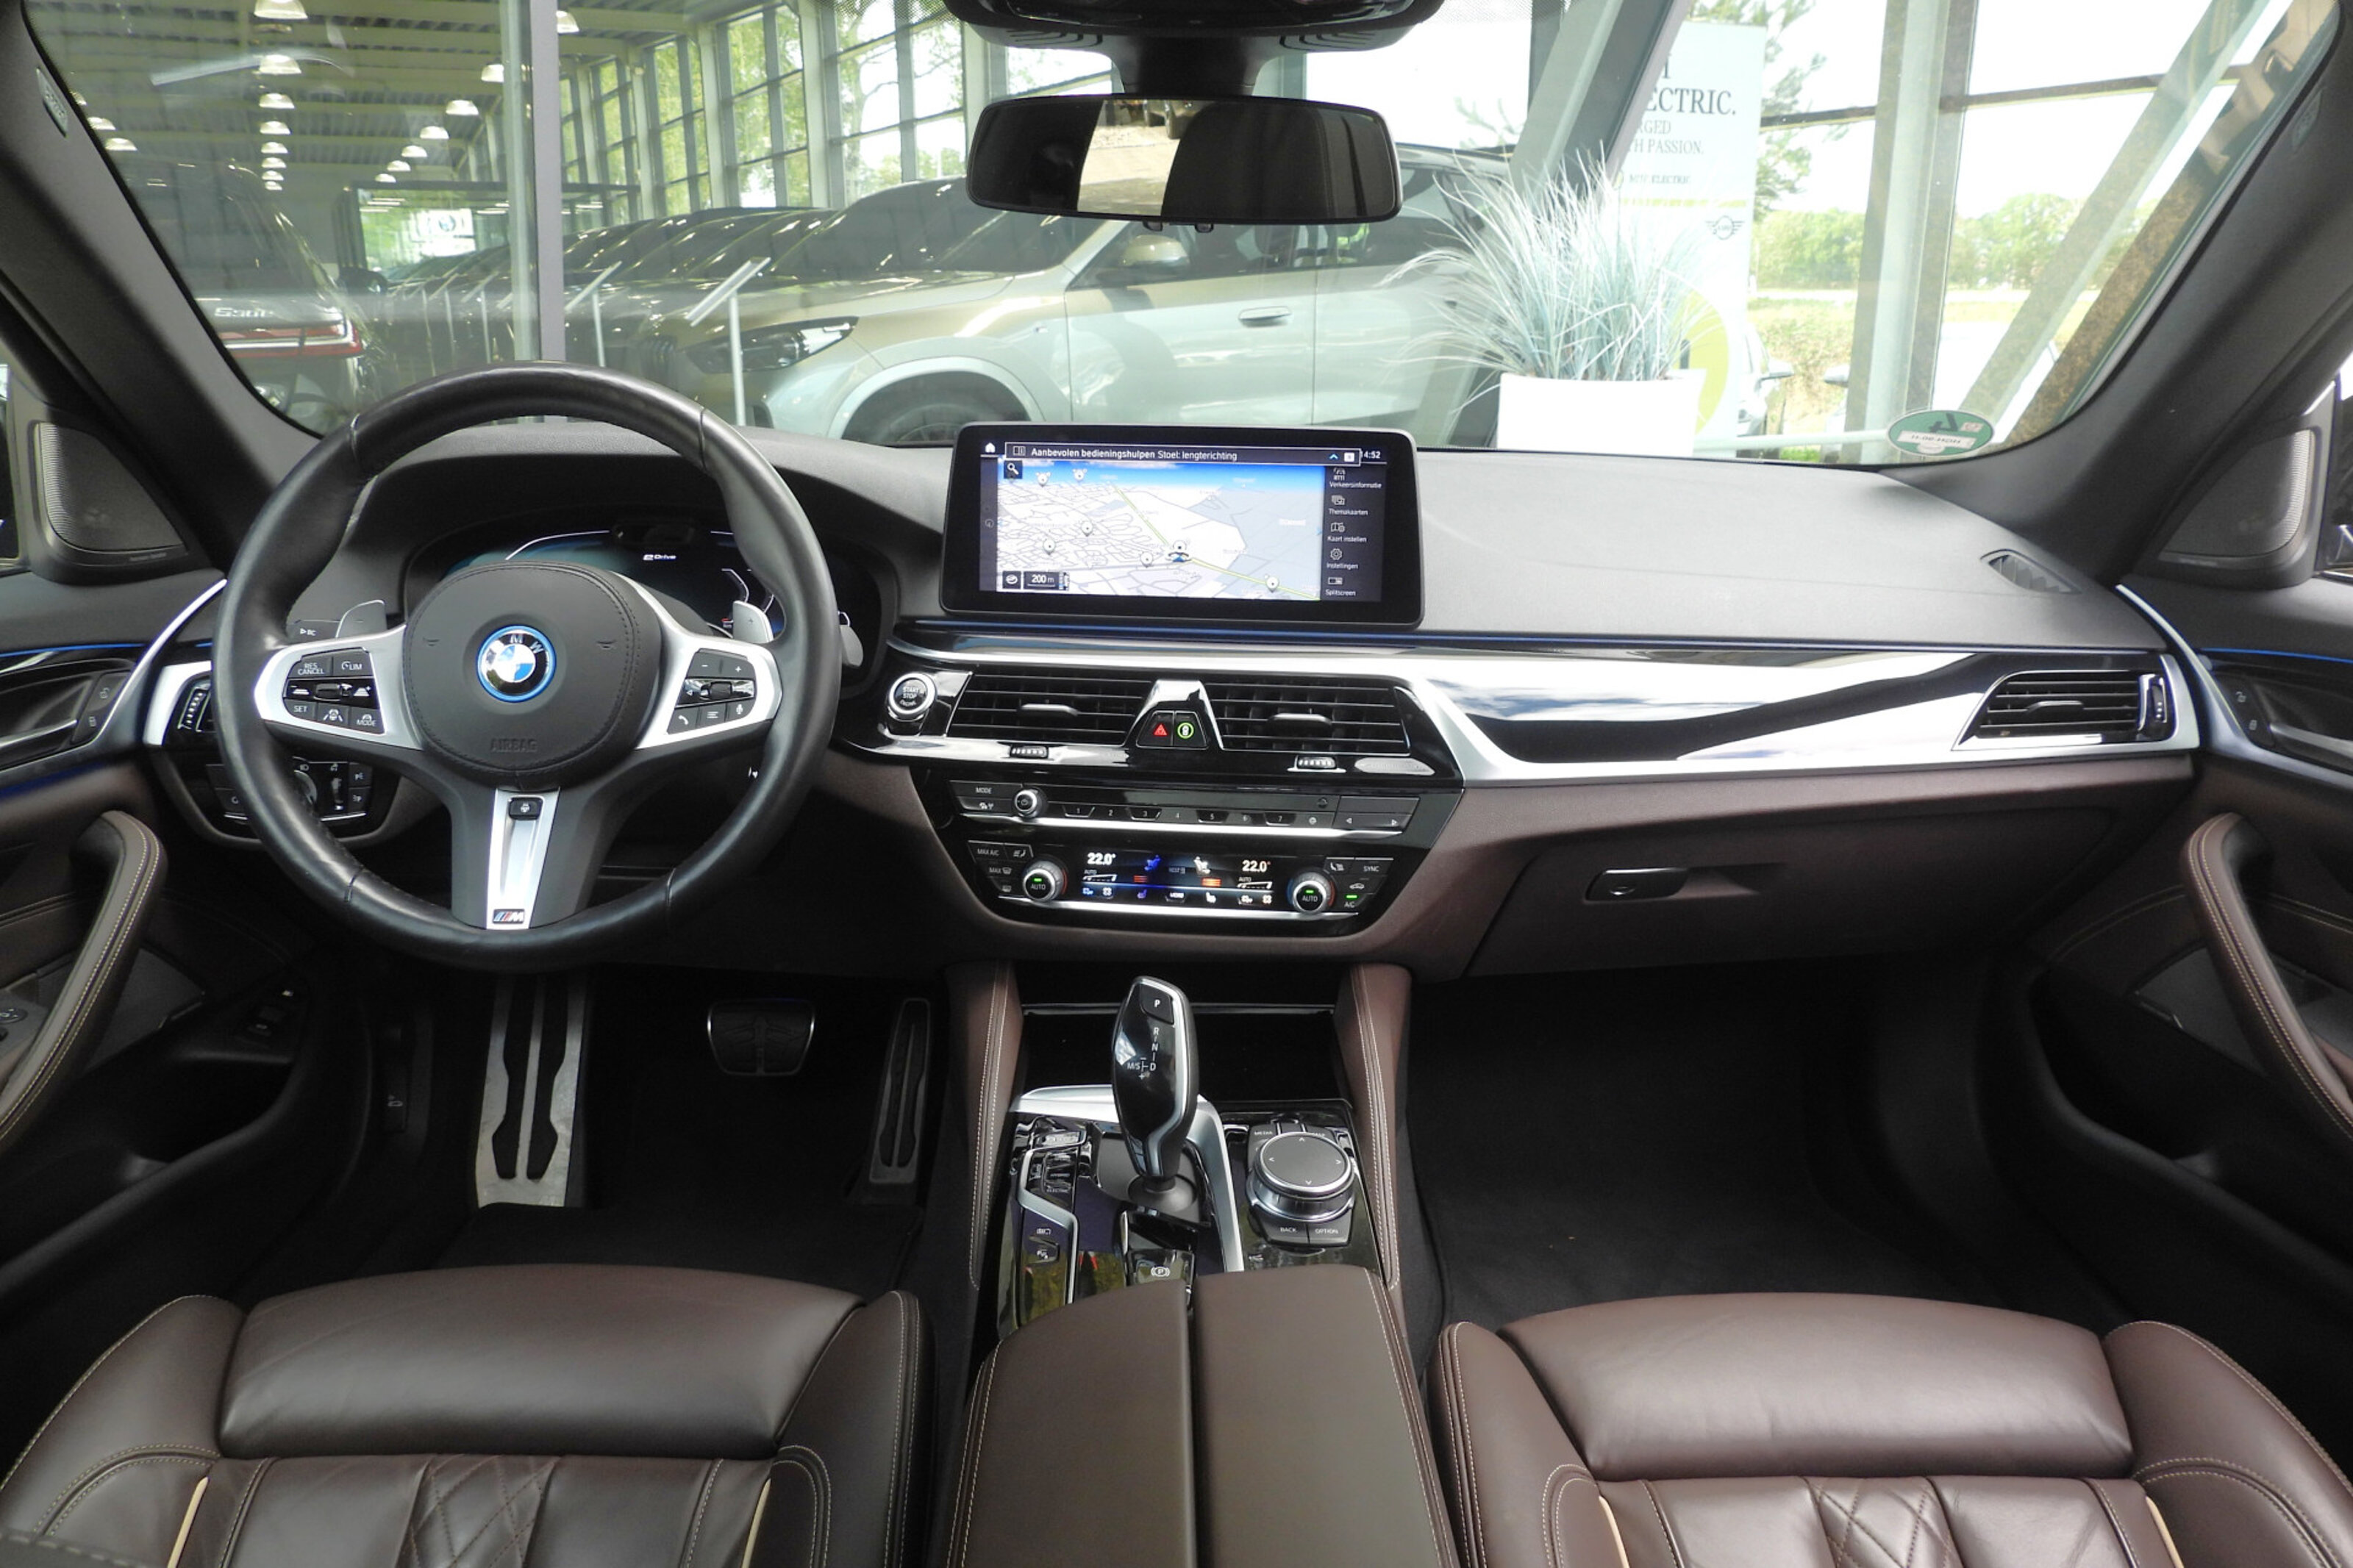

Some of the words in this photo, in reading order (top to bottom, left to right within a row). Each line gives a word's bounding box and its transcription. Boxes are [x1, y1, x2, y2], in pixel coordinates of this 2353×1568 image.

[1031, 447, 1079, 458] Aanbevolen
[1081, 448, 1155, 460] bedieningshulpen
[1157, 450, 1181, 459] Stoel:
[1182, 451, 1238, 462] lengterichting
[1327, 562, 1358, 570] Instellingen
[1031, 574, 1047, 583] 200
[357, 719, 376, 727] MODE
[490, 738, 538, 753] AIRBAG
[1302, 895, 1318, 903] AUTO
[1154, 999, 1160, 1008] P
[1153, 1027, 1160, 1036] R
[1151, 1042, 1159, 1051] N
[1149, 1062, 1157, 1071] D
